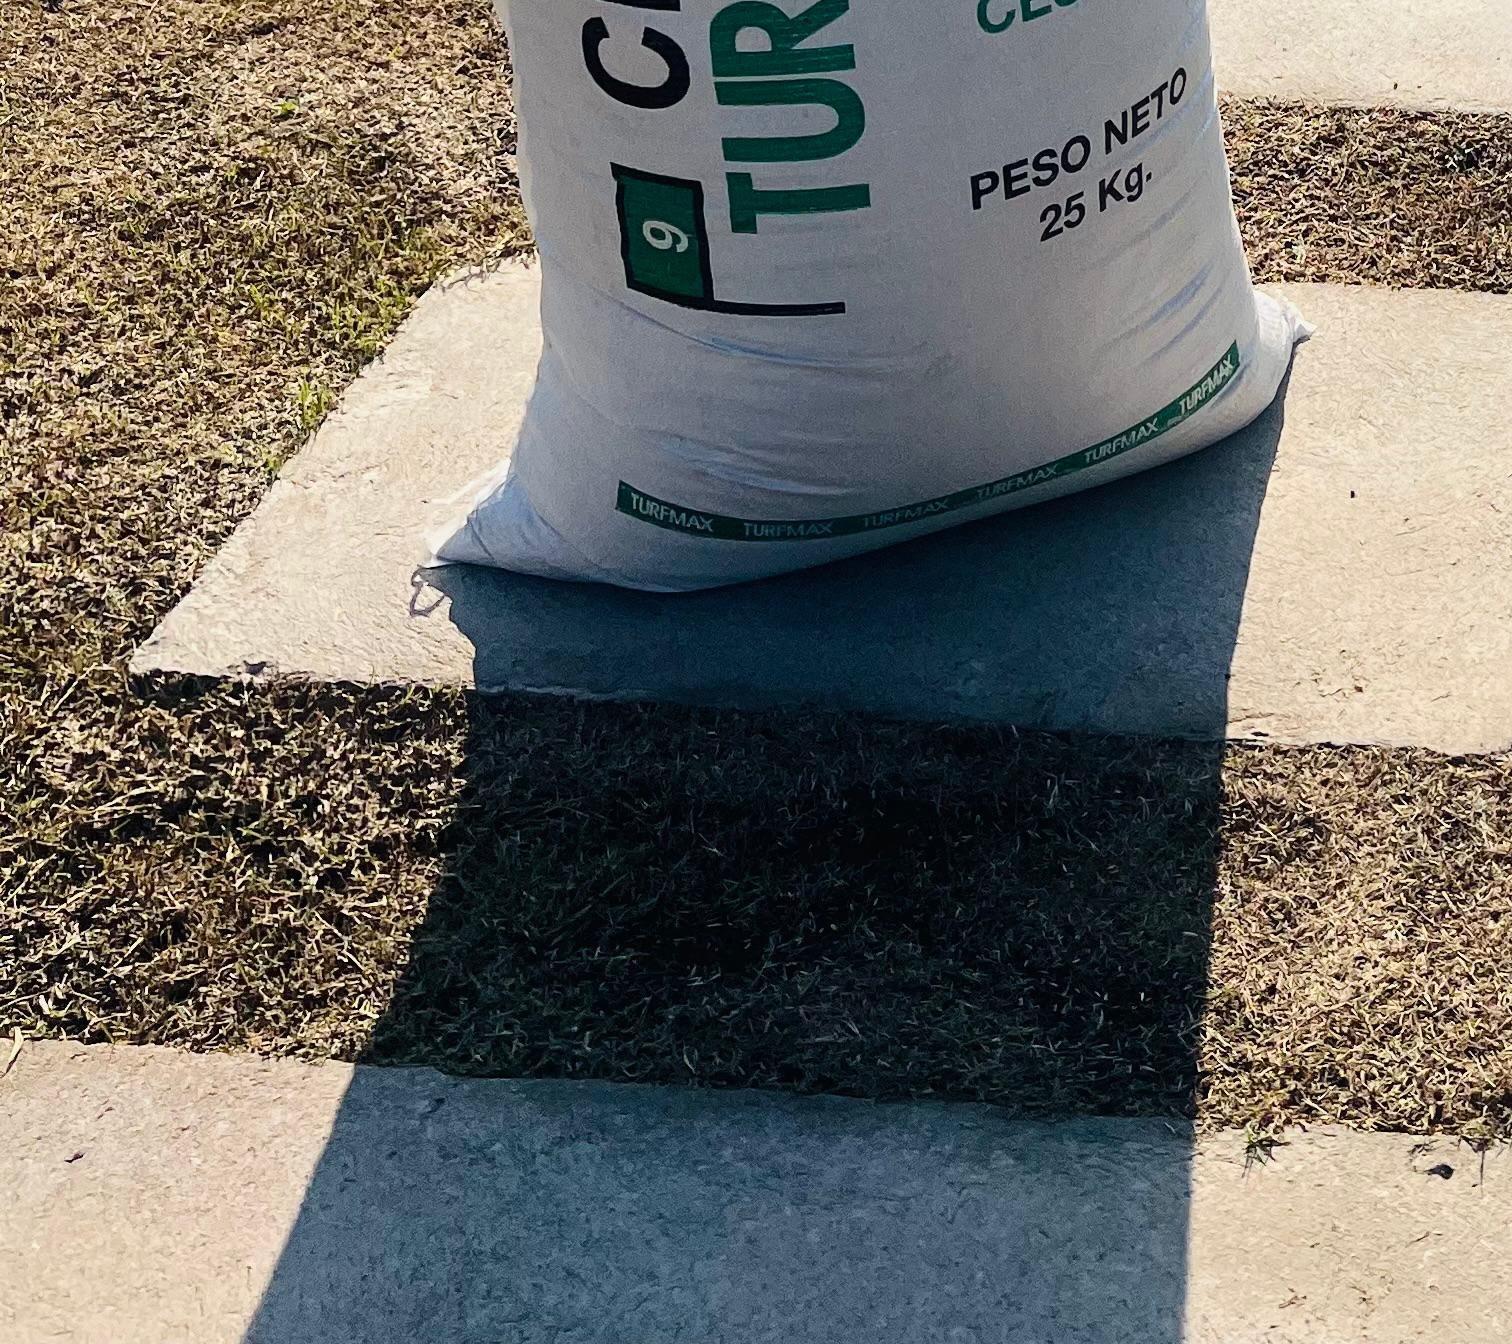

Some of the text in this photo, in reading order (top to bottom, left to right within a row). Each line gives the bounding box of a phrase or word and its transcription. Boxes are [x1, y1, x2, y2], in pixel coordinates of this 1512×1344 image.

[970, 67, 1187, 210] PESO NETO
[1039, 162, 1152, 242] 25 Kg.
[630, 354, 1235, 538] TURFMAX TURFMAX TURFMAX TURFMAX TURFMAX TURFMAX
